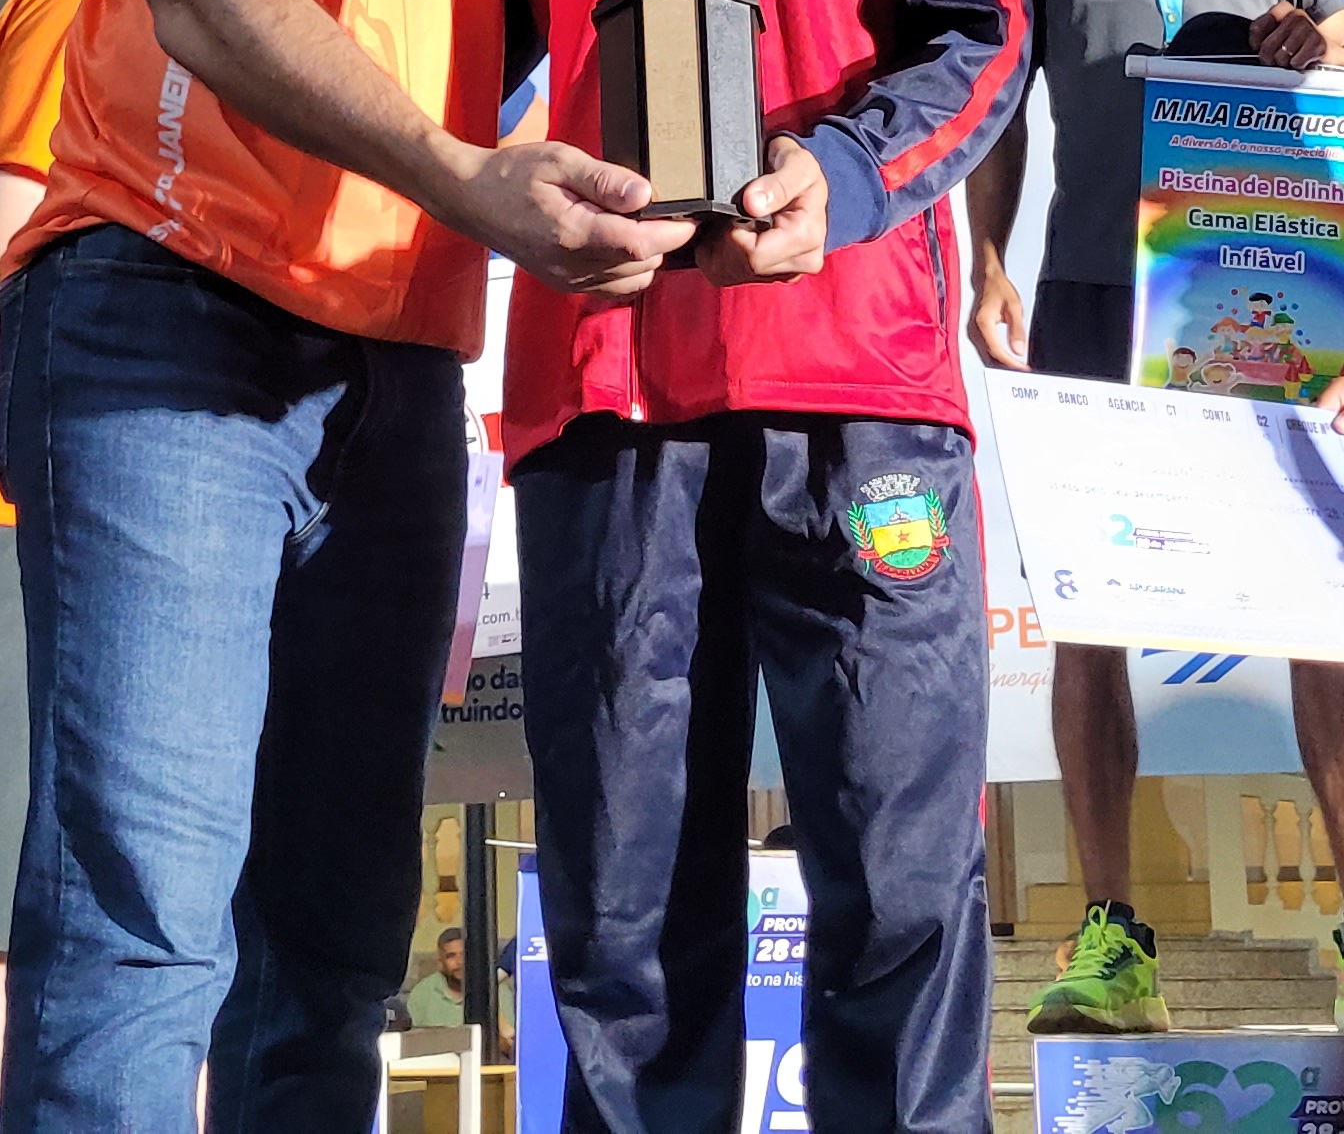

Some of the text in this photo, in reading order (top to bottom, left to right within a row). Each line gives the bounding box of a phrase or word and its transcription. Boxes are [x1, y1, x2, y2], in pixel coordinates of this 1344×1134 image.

[1161, 170, 1237, 193] Piscina
[1243, 176, 1269, 195] de
[1189, 209, 1339, 237] Cama Elástica
[1222, 247, 1303, 271] Inflável
[1012, 386, 1039, 401] COMP
[1058, 391, 1089, 406] BANCO
[1108, 395, 1146, 412] AGÊNCIA
[1203, 408, 1232, 422] CONTA
[1256, 415, 1270, 428] C2
[1285, 418, 1319, 434] CHEQUE
[441, 697, 523, 724] truindo
[756, 938, 791, 962] 28
[764, 974, 781, 987] na
